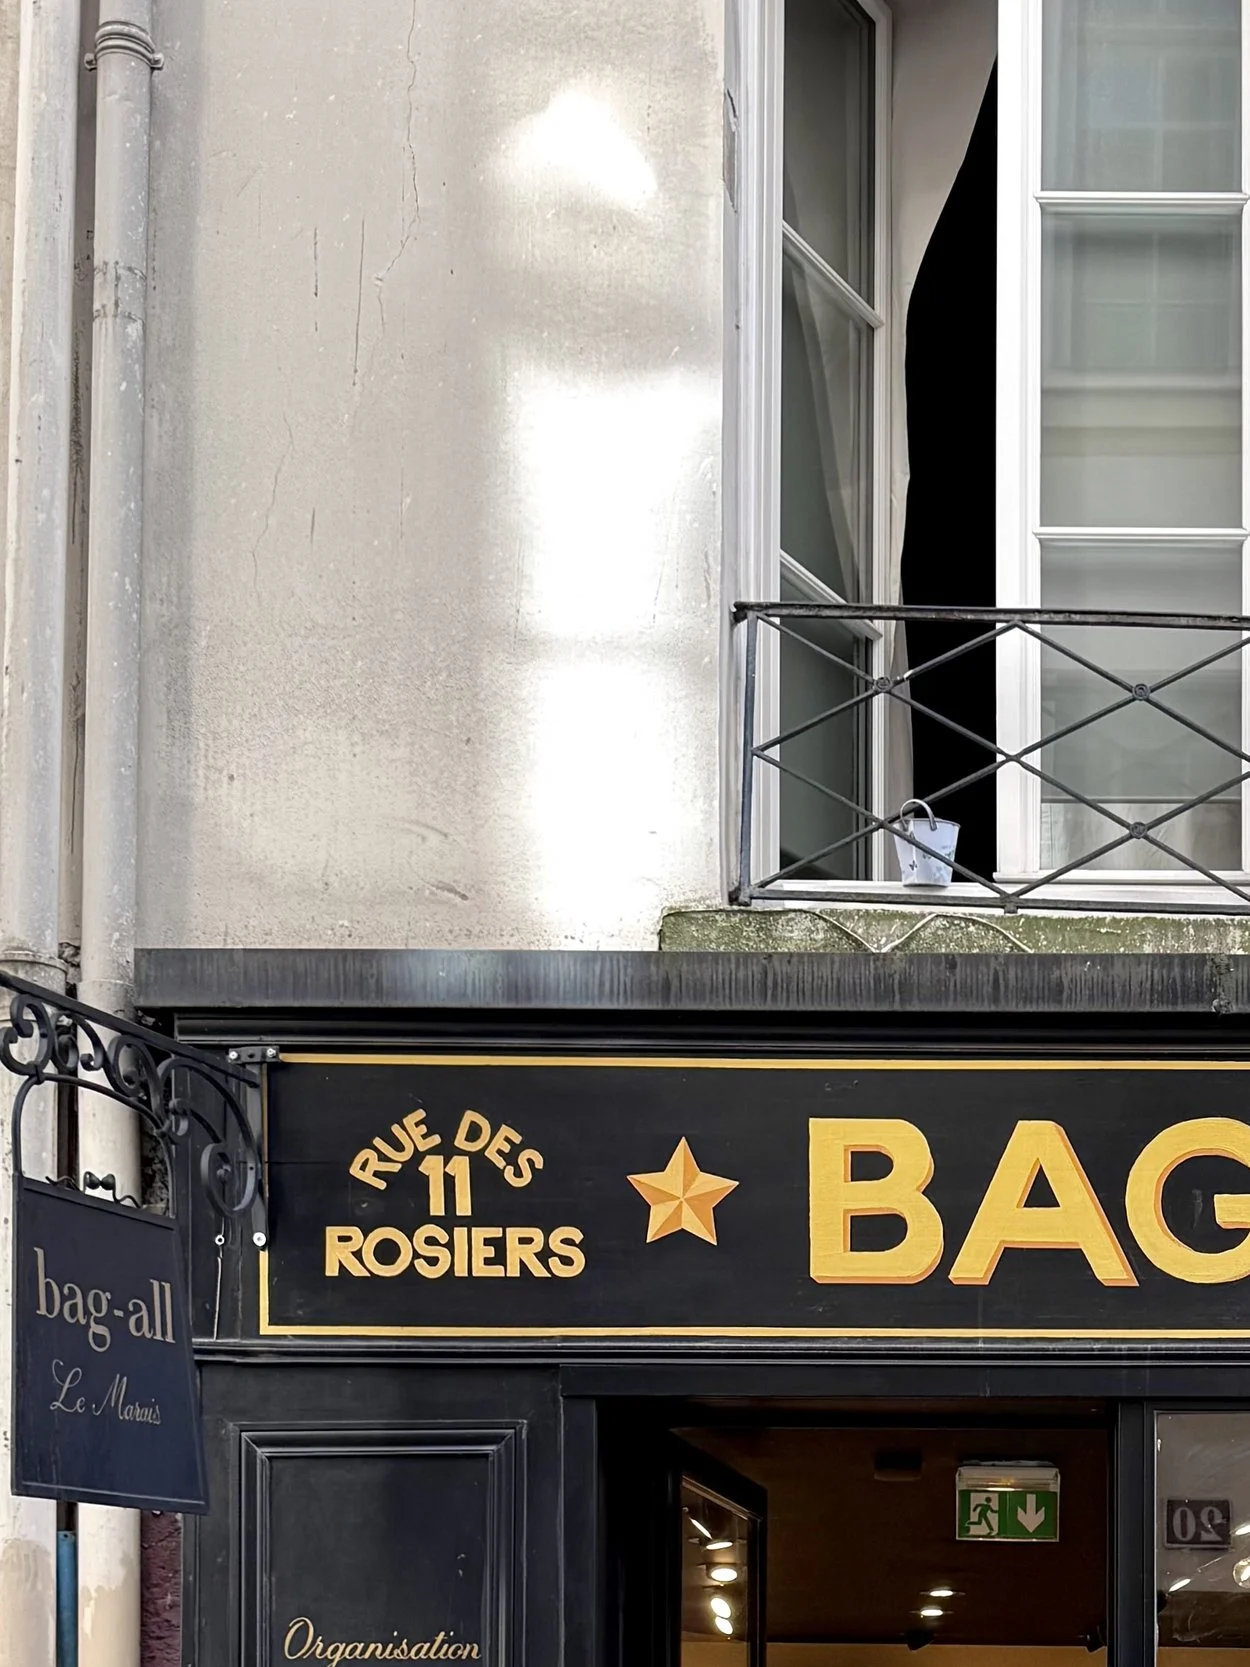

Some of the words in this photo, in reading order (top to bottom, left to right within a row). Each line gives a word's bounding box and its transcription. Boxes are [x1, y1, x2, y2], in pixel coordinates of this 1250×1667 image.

[349, 1108, 441, 1190] RUE
[455, 1110, 543, 1188] DES
[418, 1155, 472, 1216] 11
[325, 1223, 586, 1278] ROSIERS
[33, 1247, 176, 1352] bag-all
[50, 1359, 86, 1414] Le
[92, 1373, 162, 1425] Marais
